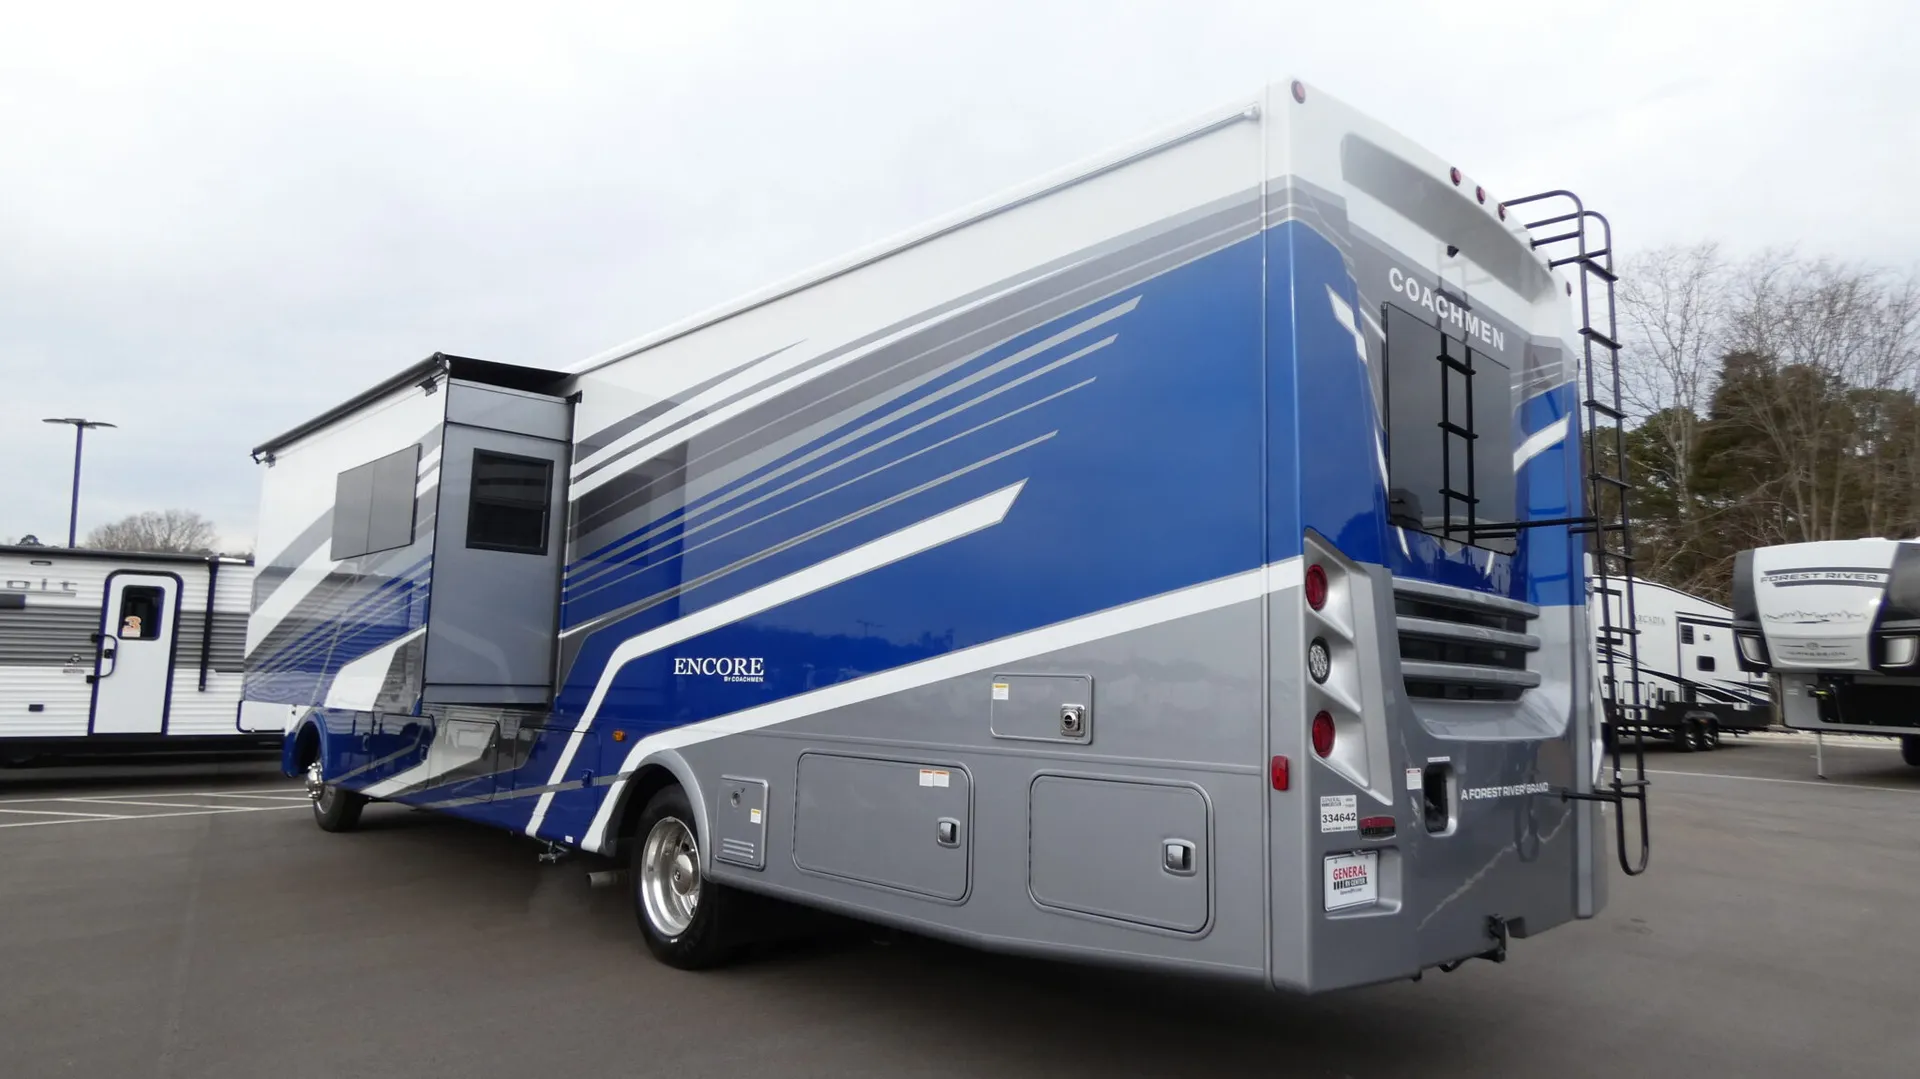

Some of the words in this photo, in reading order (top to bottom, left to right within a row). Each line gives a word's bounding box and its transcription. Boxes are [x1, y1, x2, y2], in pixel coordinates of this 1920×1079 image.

[1389, 267, 1504, 351] COACHMEN
[1760, 572, 1818, 583] FOREST
[1825, 572, 1878, 581] RIVER
[673, 657, 764, 676] ENCORE
[1461, 789, 1469, 800] A
[1469, 786, 1502, 799] FOREST
[1526, 782, 1549, 794] BRAND
[1322, 812, 1356, 824] 334642
[1333, 864, 1367, 880] GENERAL
